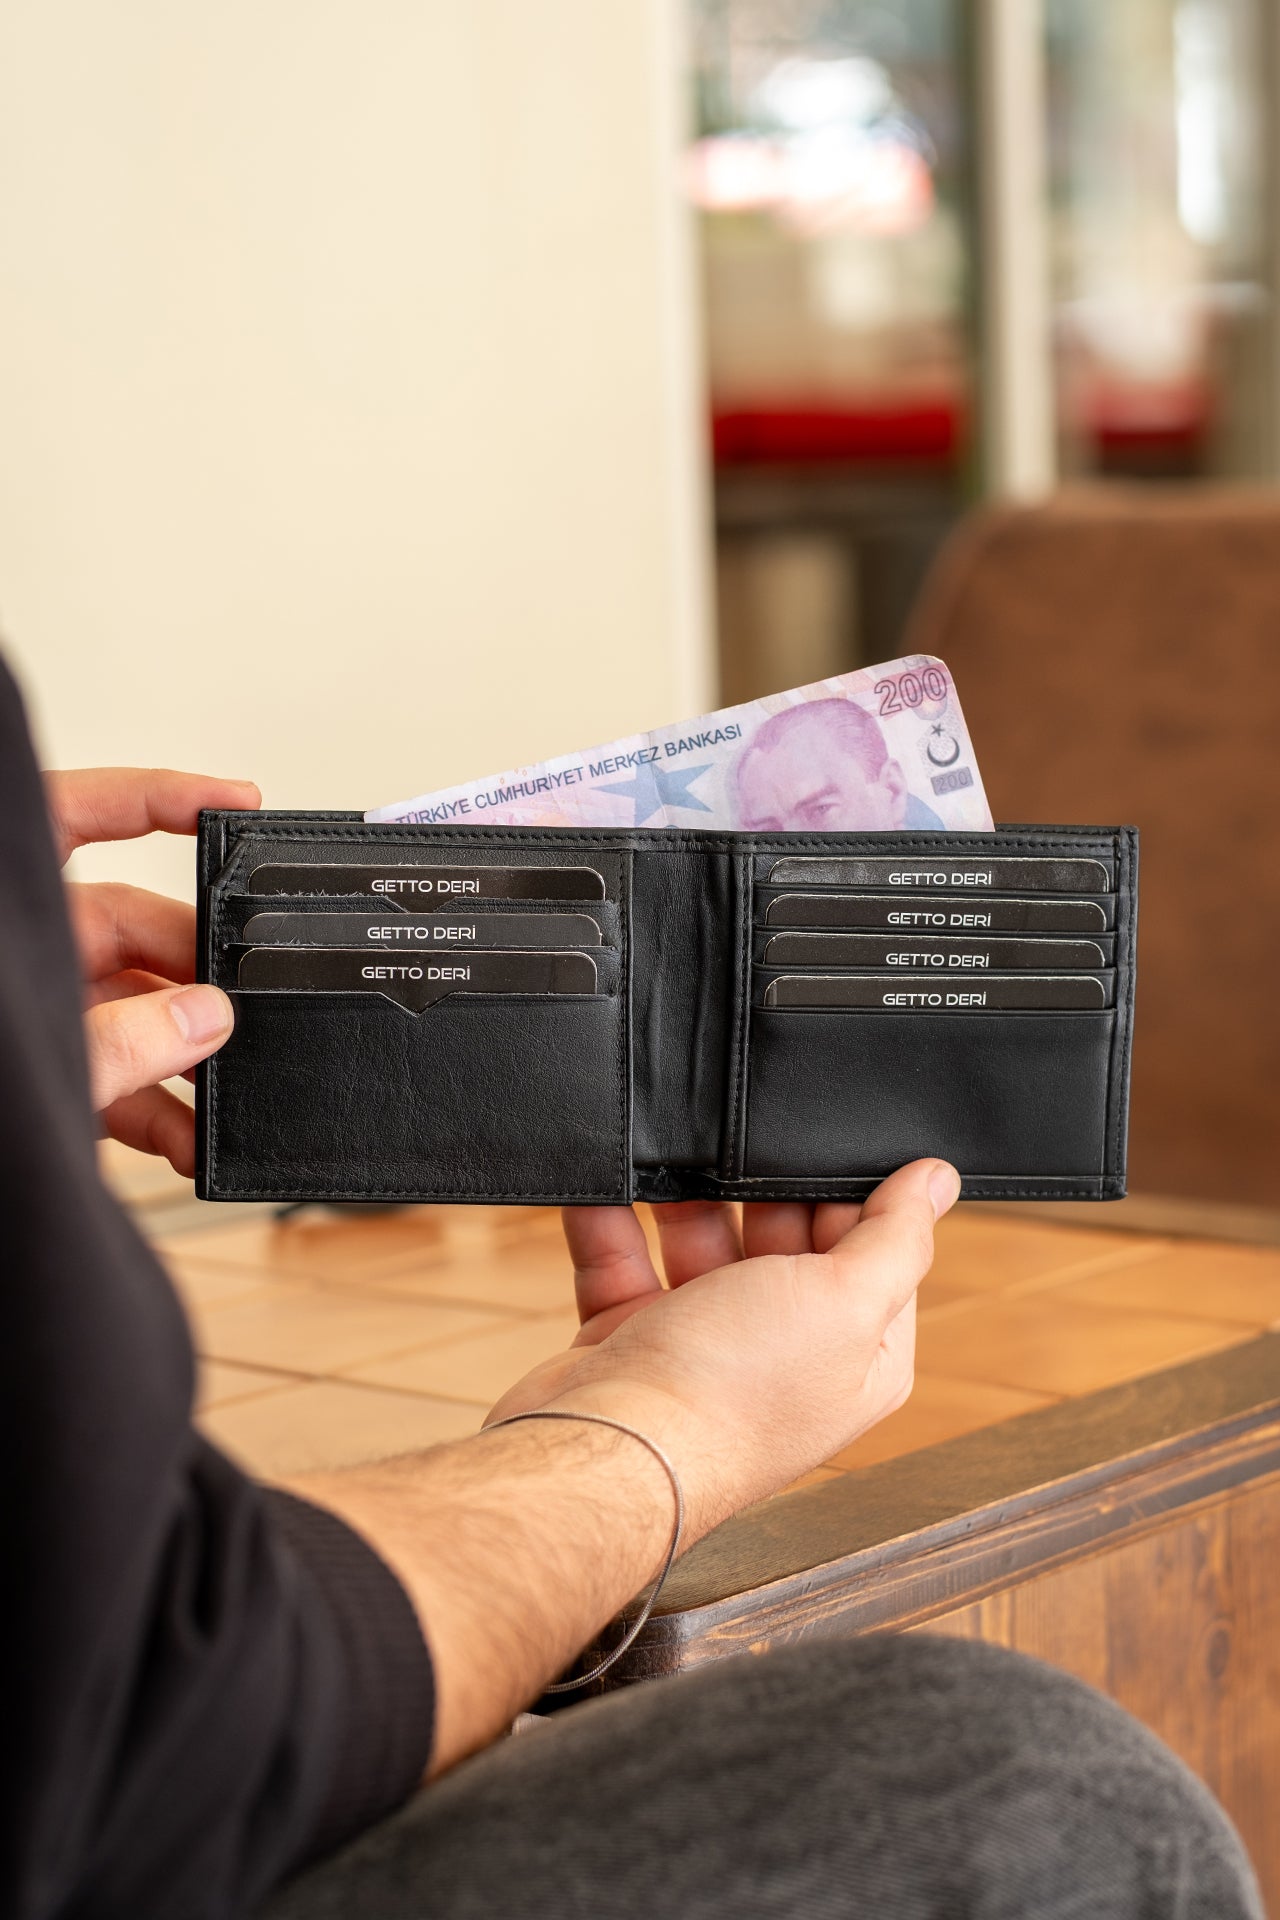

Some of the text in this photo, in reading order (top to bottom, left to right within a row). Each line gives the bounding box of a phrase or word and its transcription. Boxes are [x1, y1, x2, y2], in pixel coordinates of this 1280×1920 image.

[874, 667, 948, 716] 200
[474, 766, 584, 809] CUMHURİYET
[588, 746, 662, 778] MERKEZ
[664, 723, 742, 757] BANKASI
[937, 770, 969, 792] 200
[888, 872, 947, 885] GETTO
[371, 879, 432, 893] GETTO
[887, 912, 946, 925] GETTO
[367, 926, 428, 940] GETTO
[886, 953, 945, 966] GETTO
[361, 965, 423, 979] GETTO
[882, 993, 942, 1006] GETTO
